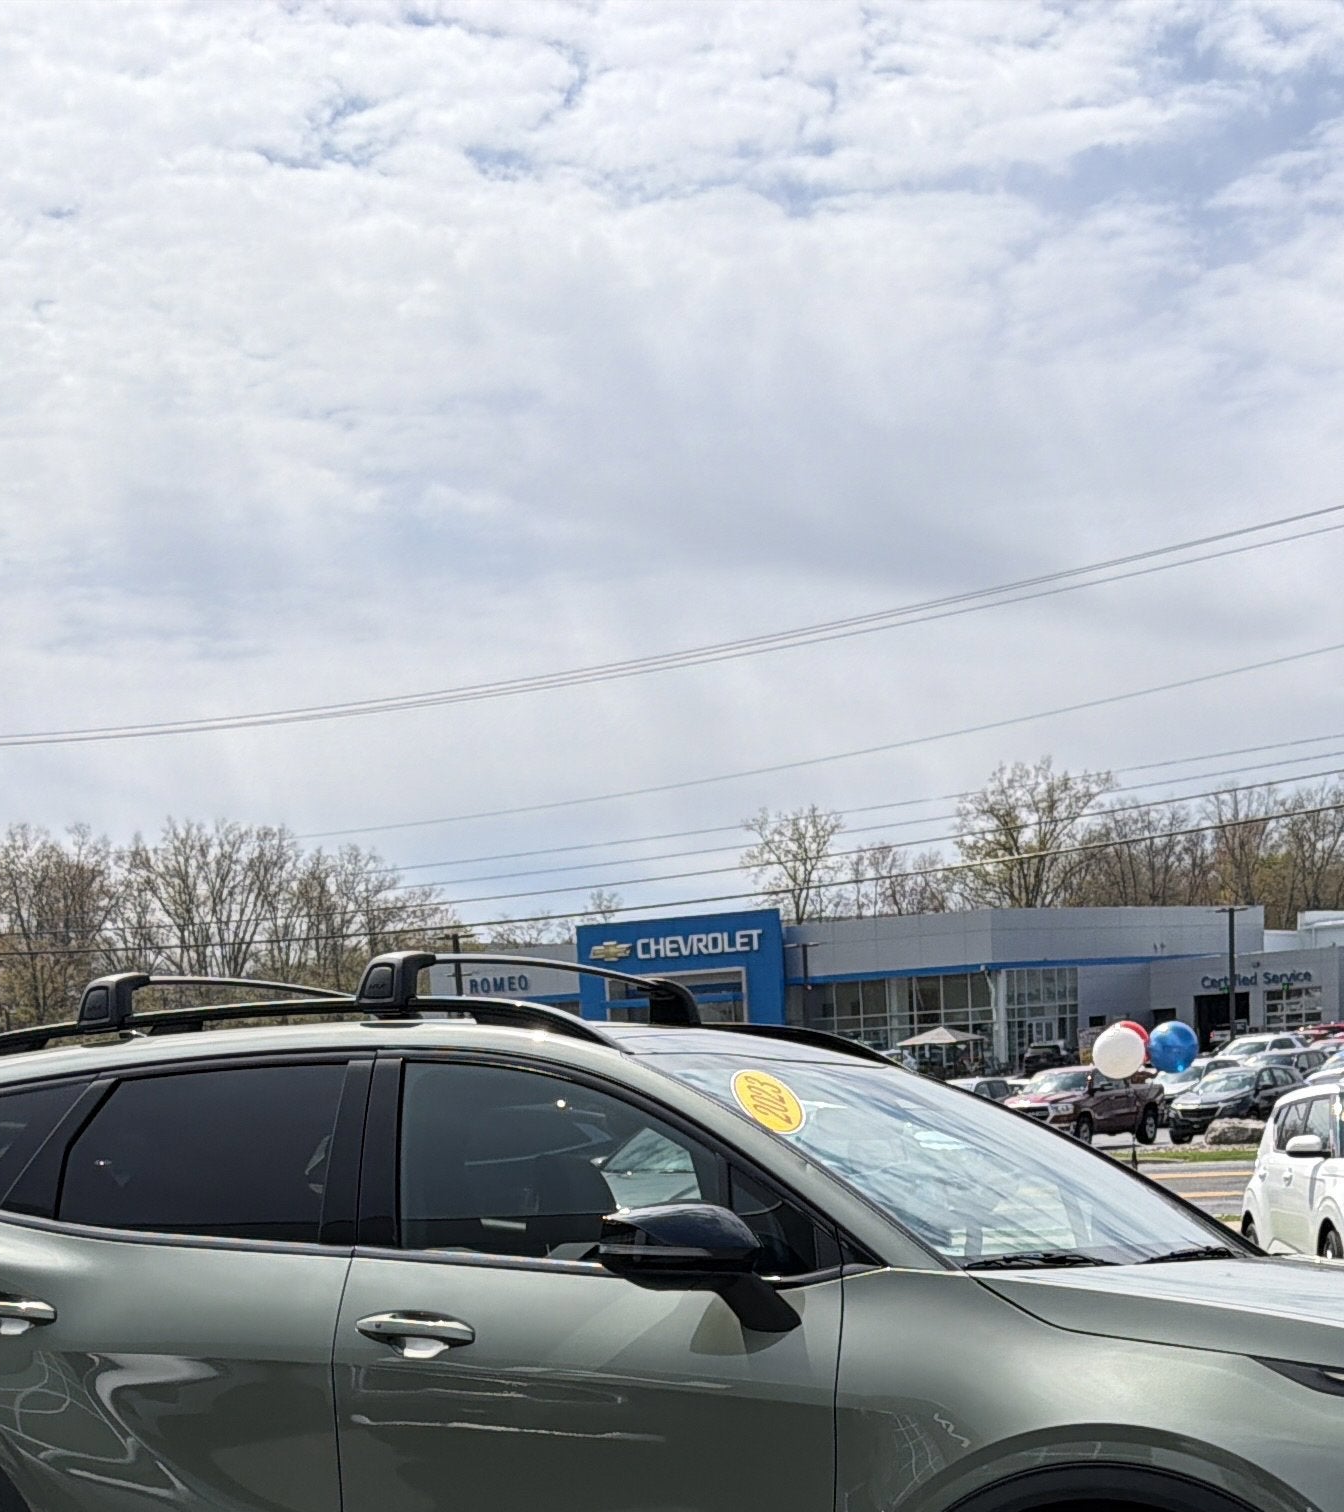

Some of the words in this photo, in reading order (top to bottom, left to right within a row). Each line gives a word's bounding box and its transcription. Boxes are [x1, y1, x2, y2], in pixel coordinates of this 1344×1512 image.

[636, 929, 763, 960] CHEVROLET
[469, 974, 529, 994] ROMEO
[1201, 971, 1258, 990] Certied
[1262, 969, 1312, 985] Service
[743, 1075, 793, 1125] 2023
